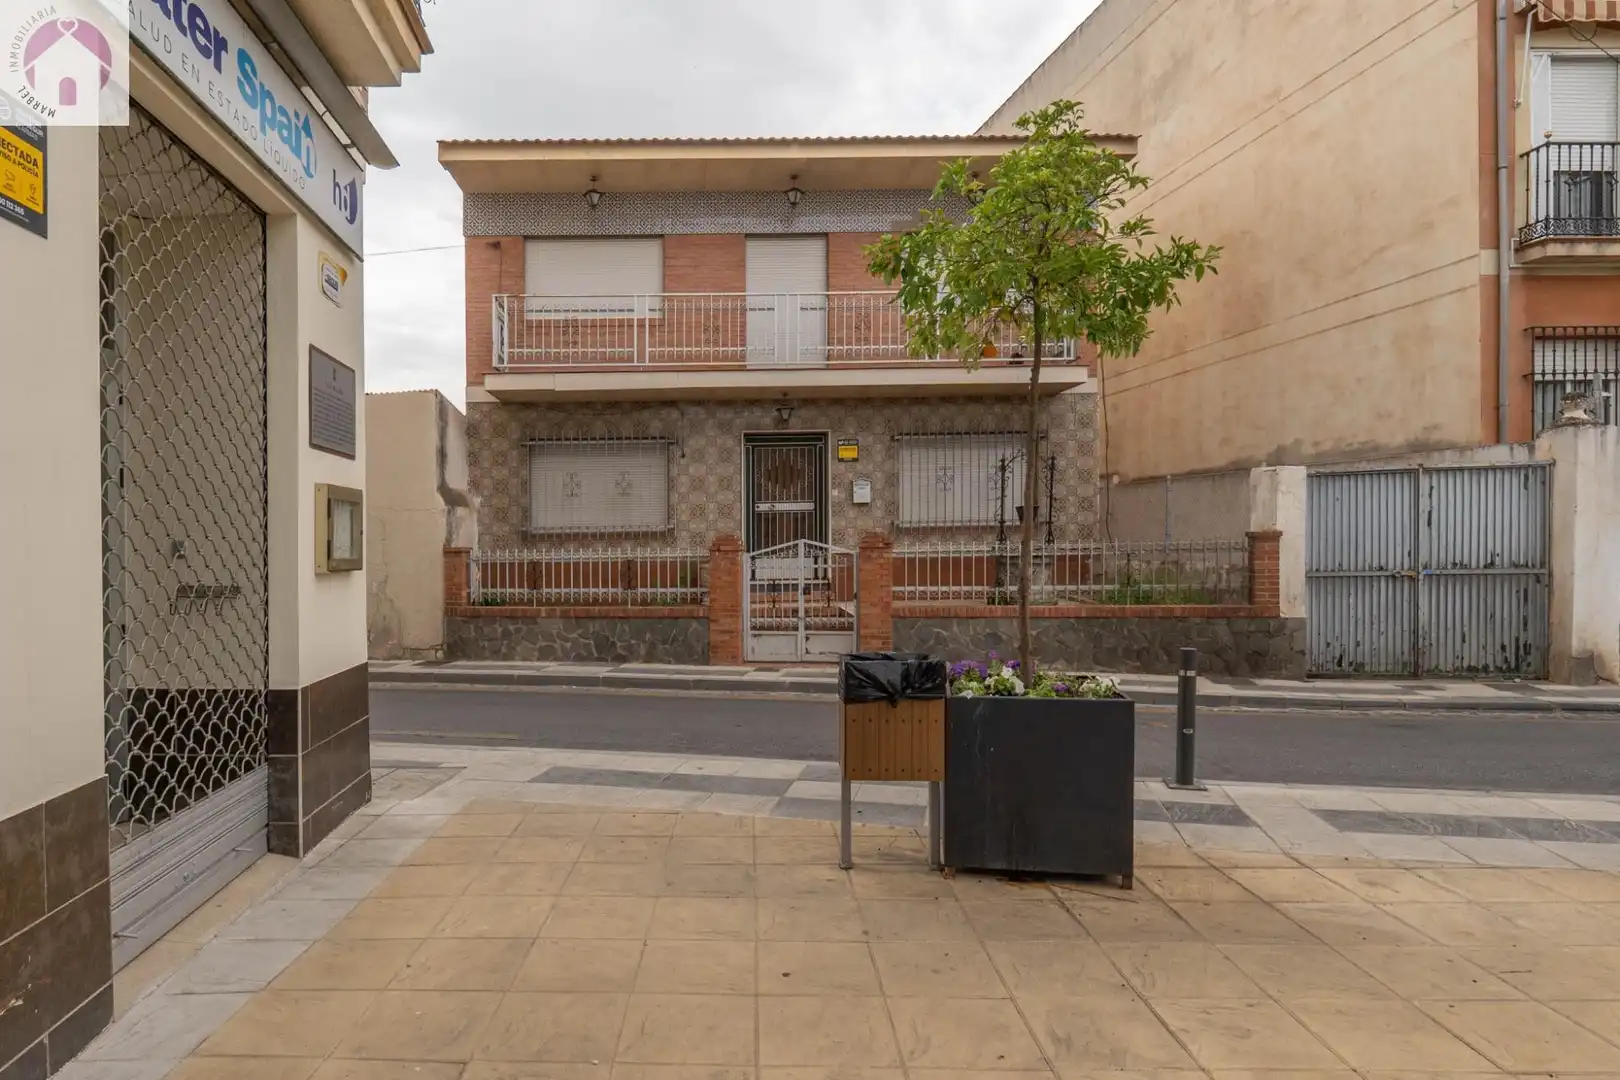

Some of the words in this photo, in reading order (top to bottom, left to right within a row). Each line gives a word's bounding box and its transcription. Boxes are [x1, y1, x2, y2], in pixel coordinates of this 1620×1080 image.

[181, 52, 200, 84] EN
[208, 80, 258, 141] ESTADO
[236, 47, 317, 178] Spain
